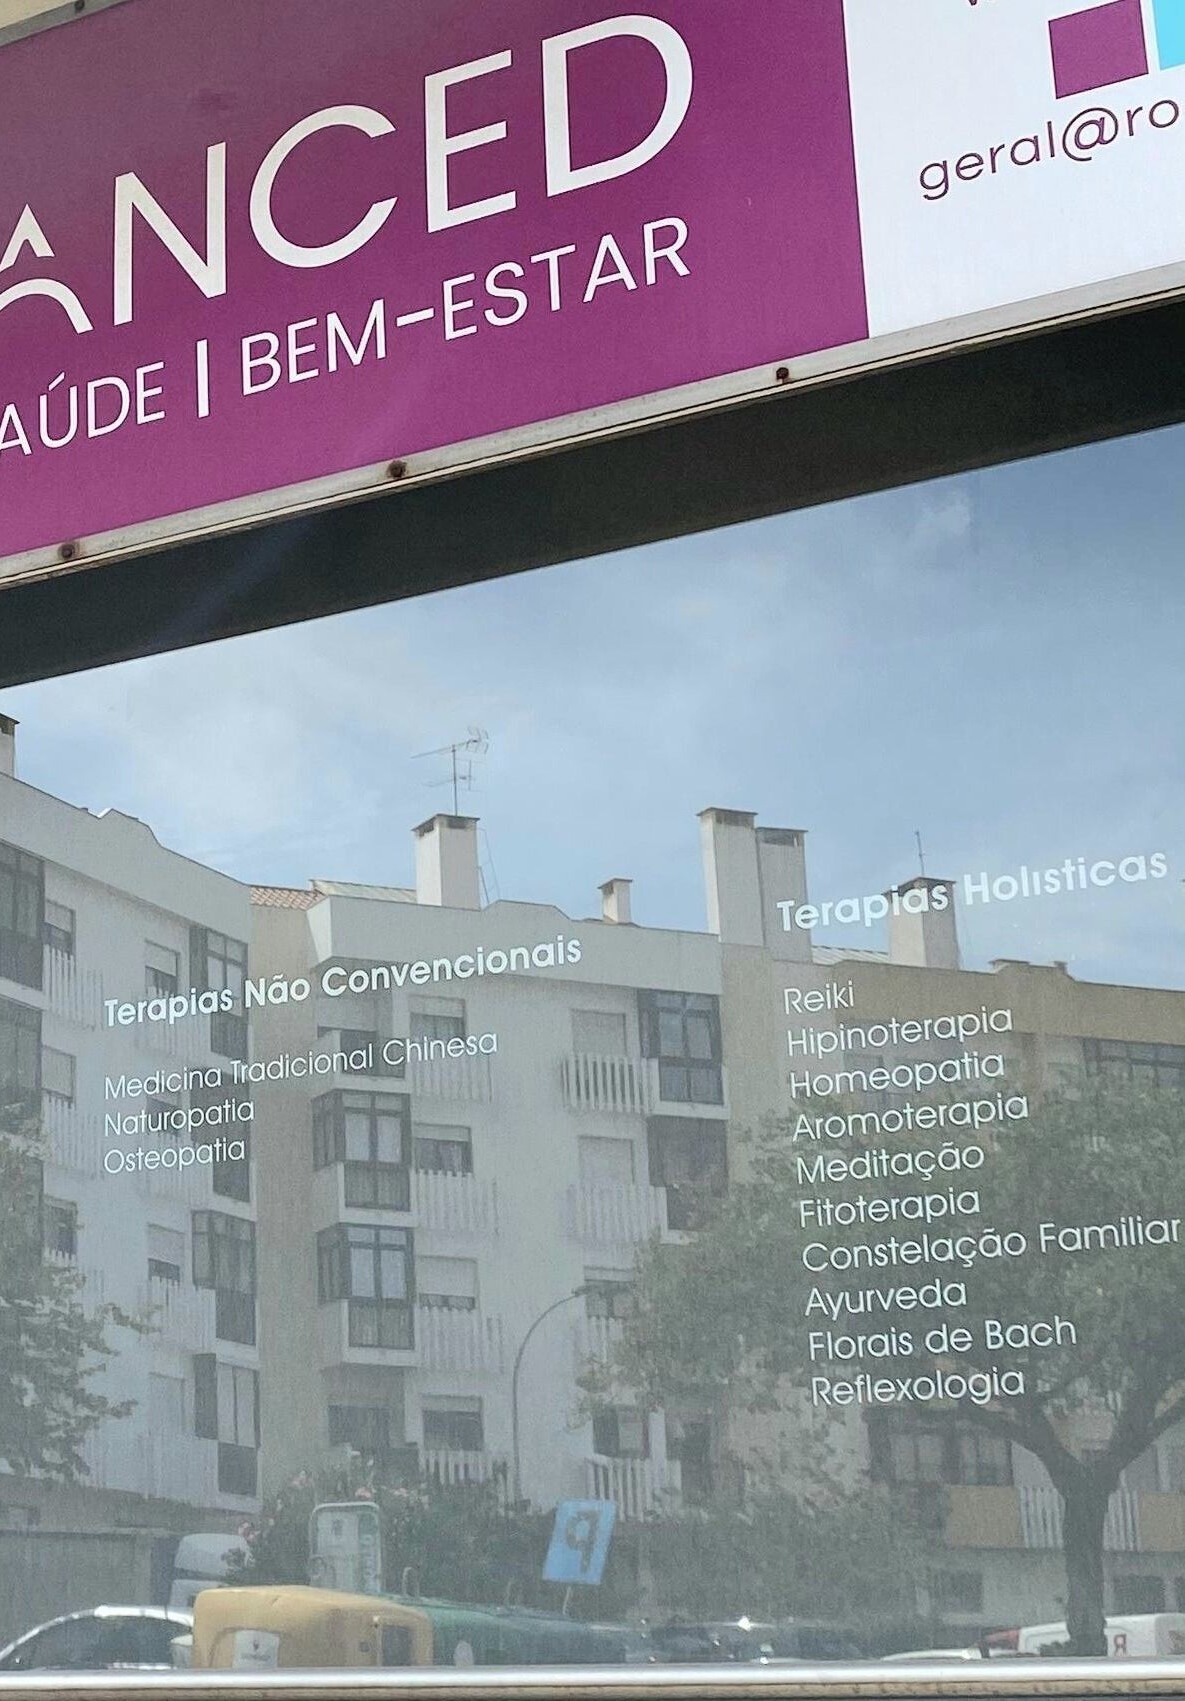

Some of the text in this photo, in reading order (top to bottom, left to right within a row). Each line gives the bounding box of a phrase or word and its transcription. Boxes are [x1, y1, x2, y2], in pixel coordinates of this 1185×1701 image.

[919, 99, 1180, 201] geral@ro
[240, 216, 692, 397] BEM-ESTAR
[776, 883, 950, 931] Terapias
[104, 934, 583, 1028] Terapias Não Convencionais
[783, 980, 855, 1015] Reiki
[787, 1005, 1013, 1059] Hipinoterapia
[104, 1031, 499, 1100] Medicina Tradicional Chinesa
[790, 1051, 1005, 1100] Homeopatia
[104, 1098, 255, 1139] Naturopatia
[792, 1092, 1029, 1142] Aromoterapia
[103, 1137, 245, 1176] Osteopatia
[796, 1141, 985, 1185] Meditação
[799, 1187, 981, 1228] Fitoterapia
[802, 1215, 1182, 1272] Constelação Familiar
[805, 1278, 967, 1321] Ayurveda
[808, 1315, 1077, 1361] Florais de Bach
[811, 1366, 1025, 1406] Reflexologia
